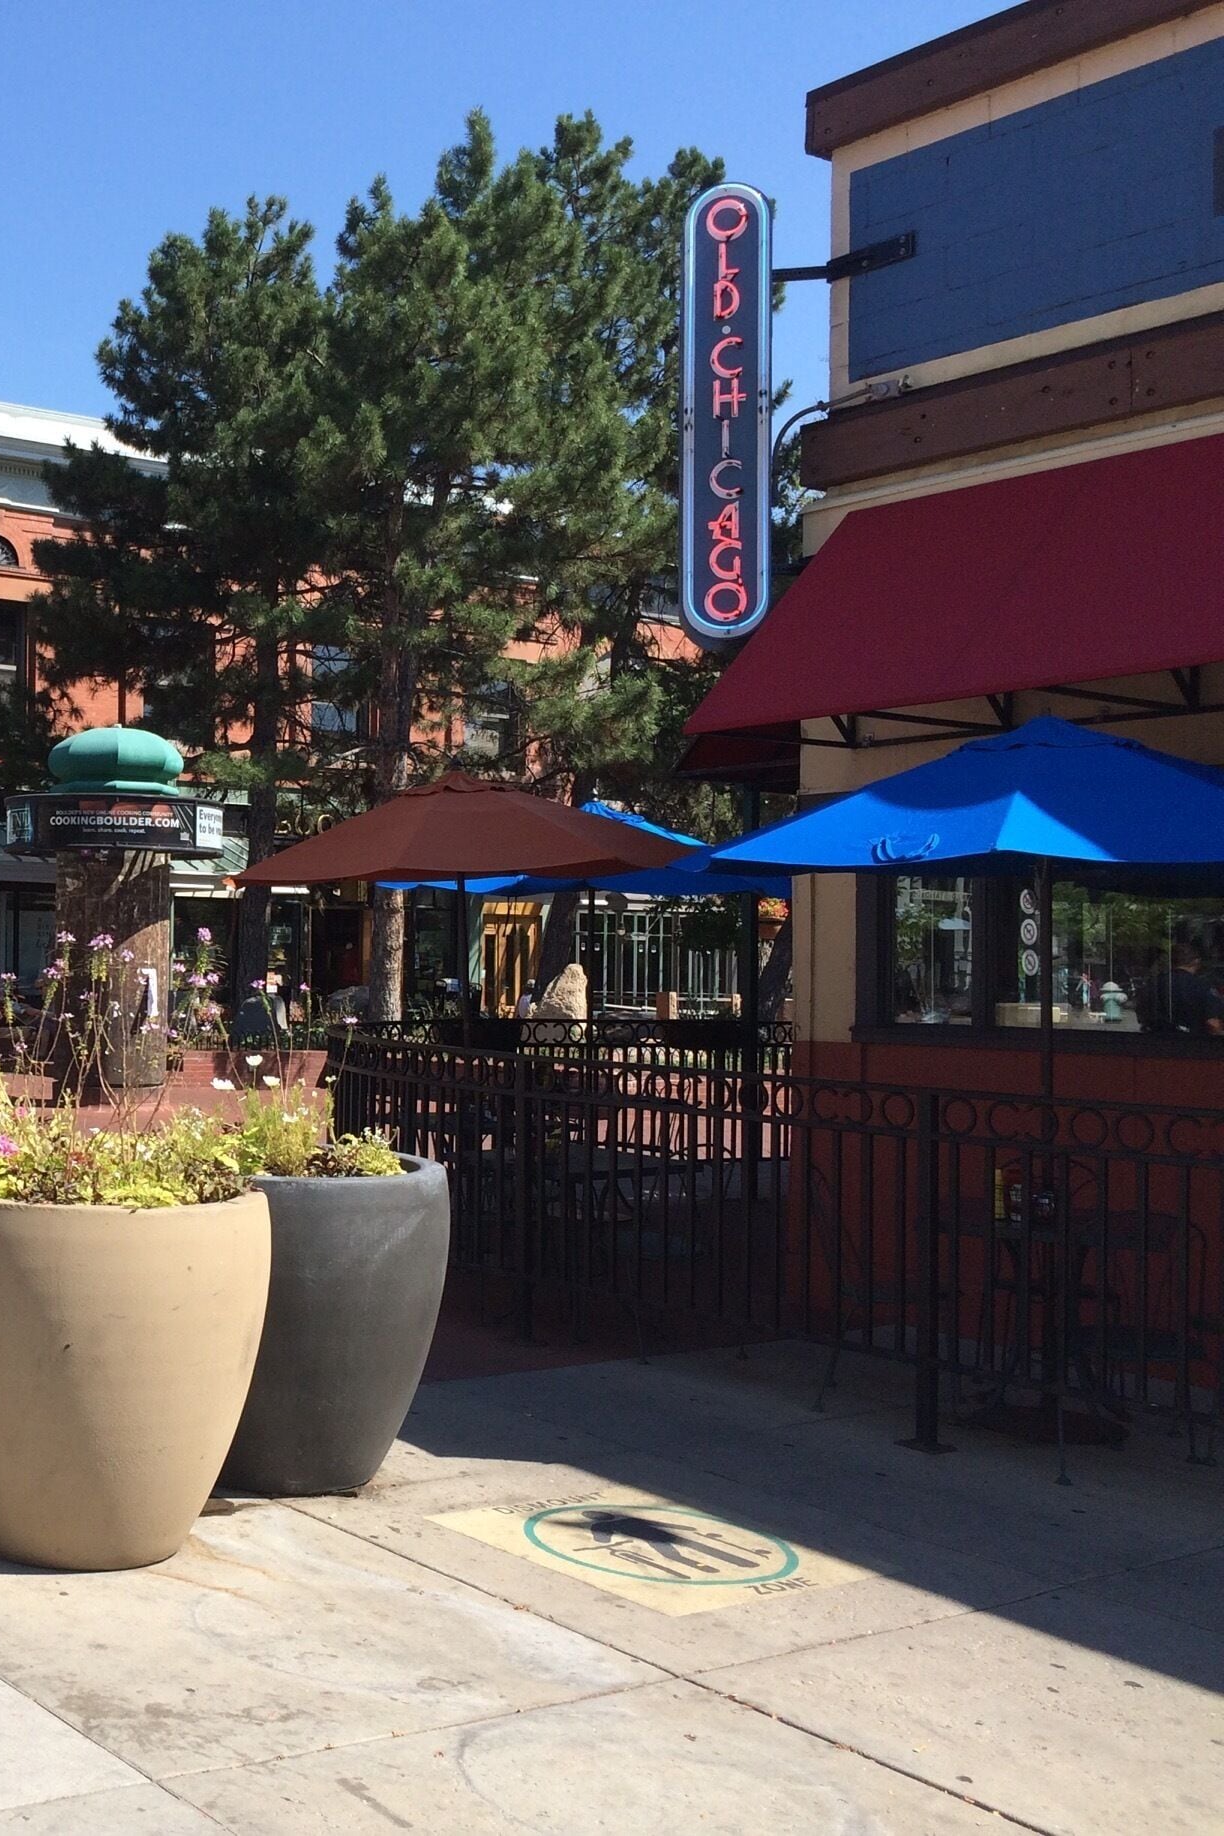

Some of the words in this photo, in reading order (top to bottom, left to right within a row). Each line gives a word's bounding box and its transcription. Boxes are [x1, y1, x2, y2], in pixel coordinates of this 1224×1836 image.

[705, 199, 749, 321] OLD
[704, 336, 748, 622] CHICAGO
[49, 815, 180, 828] COOKINGBOULDER.COM
[493, 1491, 605, 1515] DISMOUNT
[743, 1577, 819, 1595] ZONE
